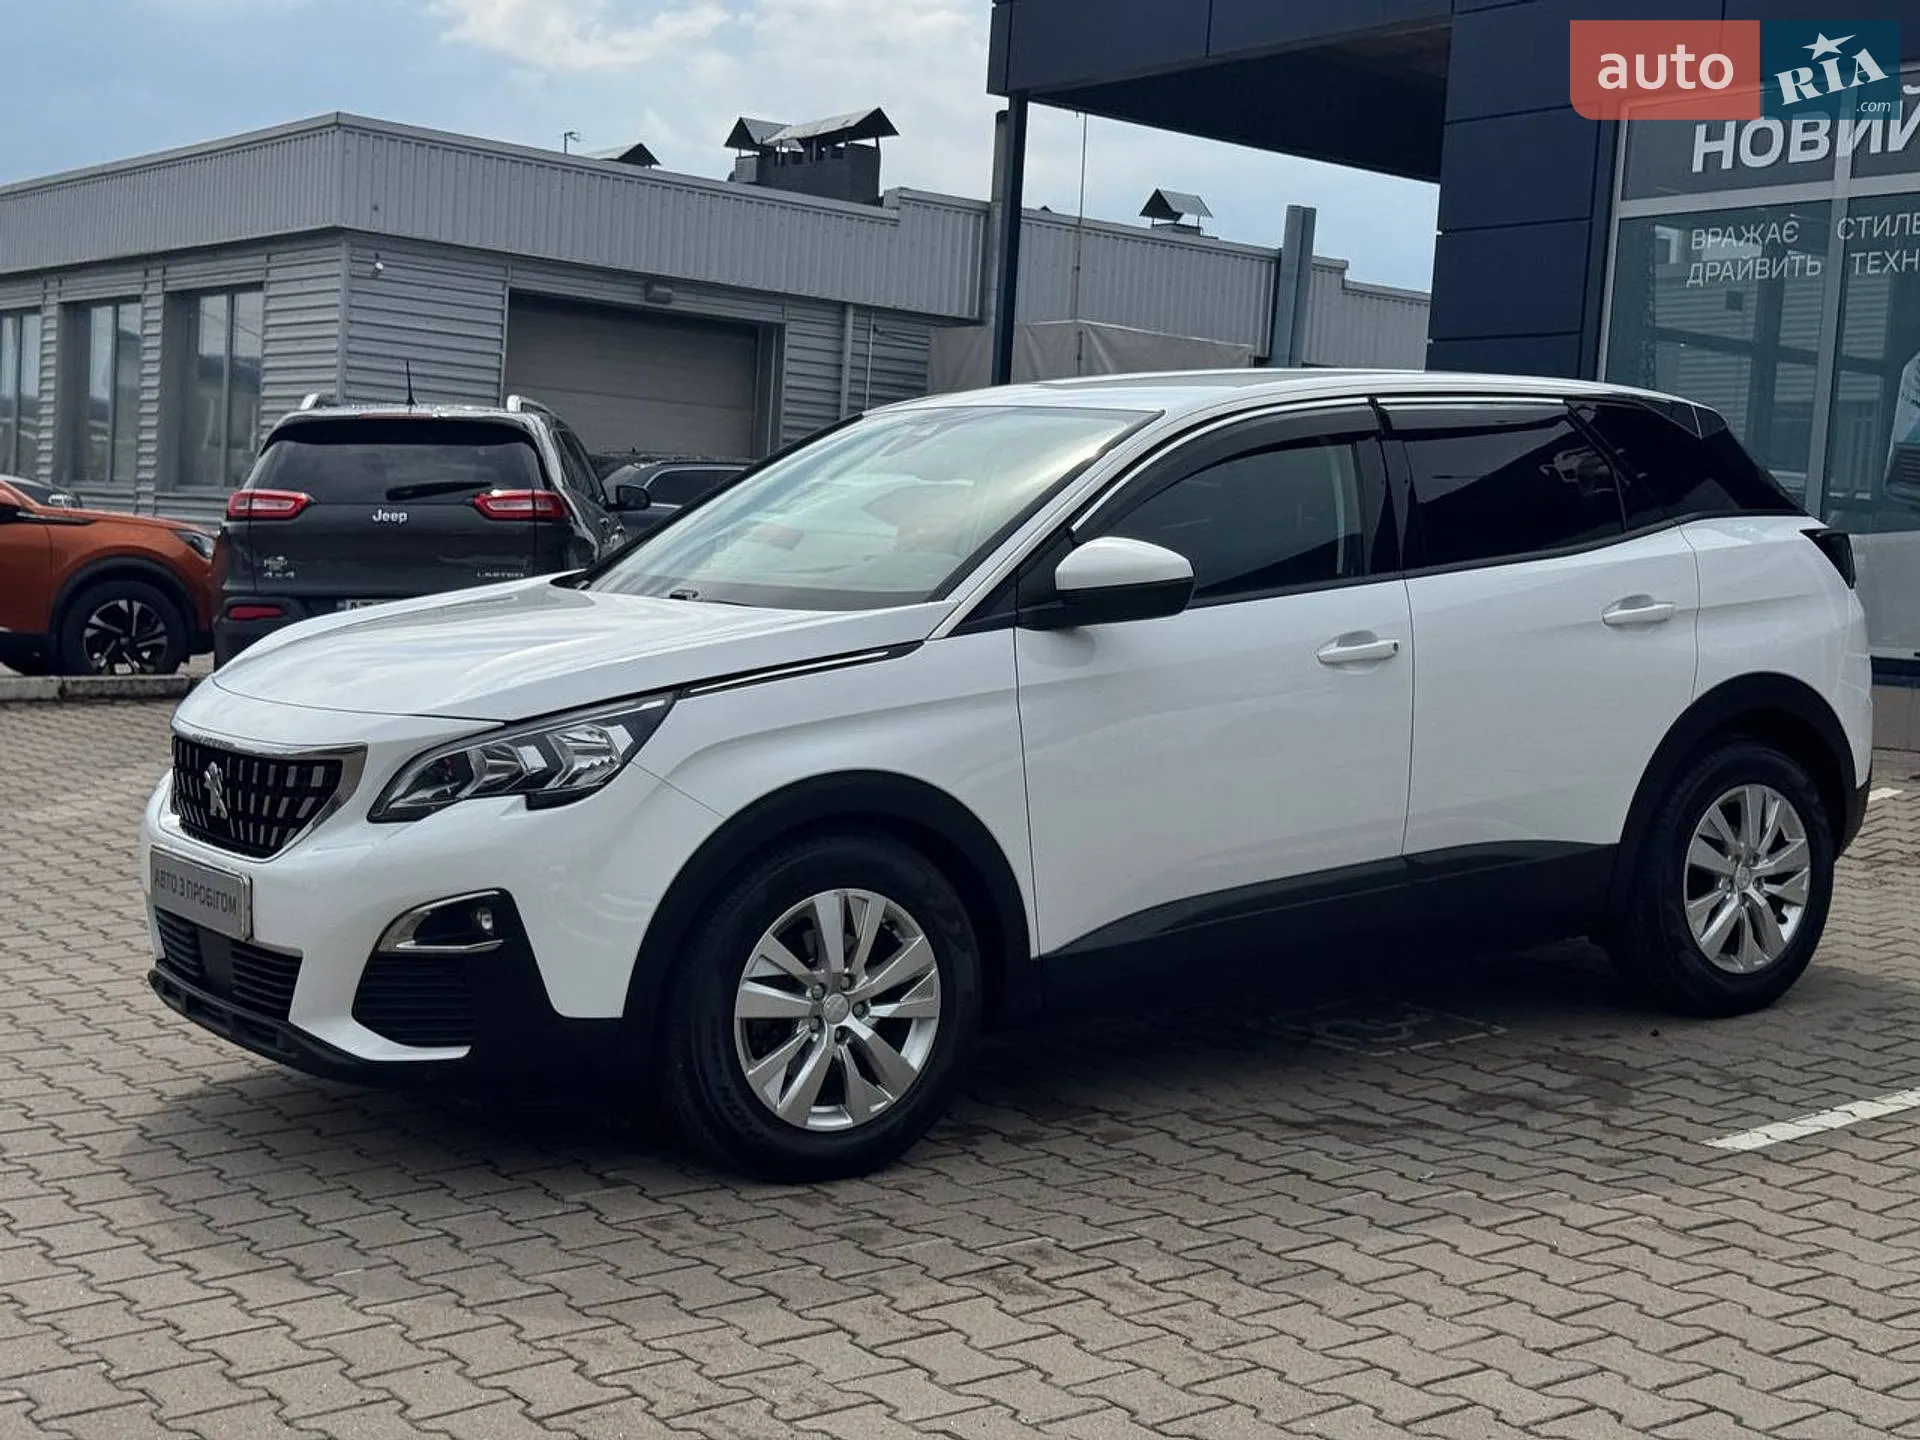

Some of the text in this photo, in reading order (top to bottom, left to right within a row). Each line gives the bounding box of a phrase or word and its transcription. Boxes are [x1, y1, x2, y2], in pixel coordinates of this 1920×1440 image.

[1691, 221, 1800, 250] ВРАЖАЄ
[1686, 253, 1821, 288] ДРАЙВИТЬ
[372, 508, 408, 525] Jeep
[154, 868, 178, 893] АВТО
[186, 880, 237, 913] ПРОБІГОМ
